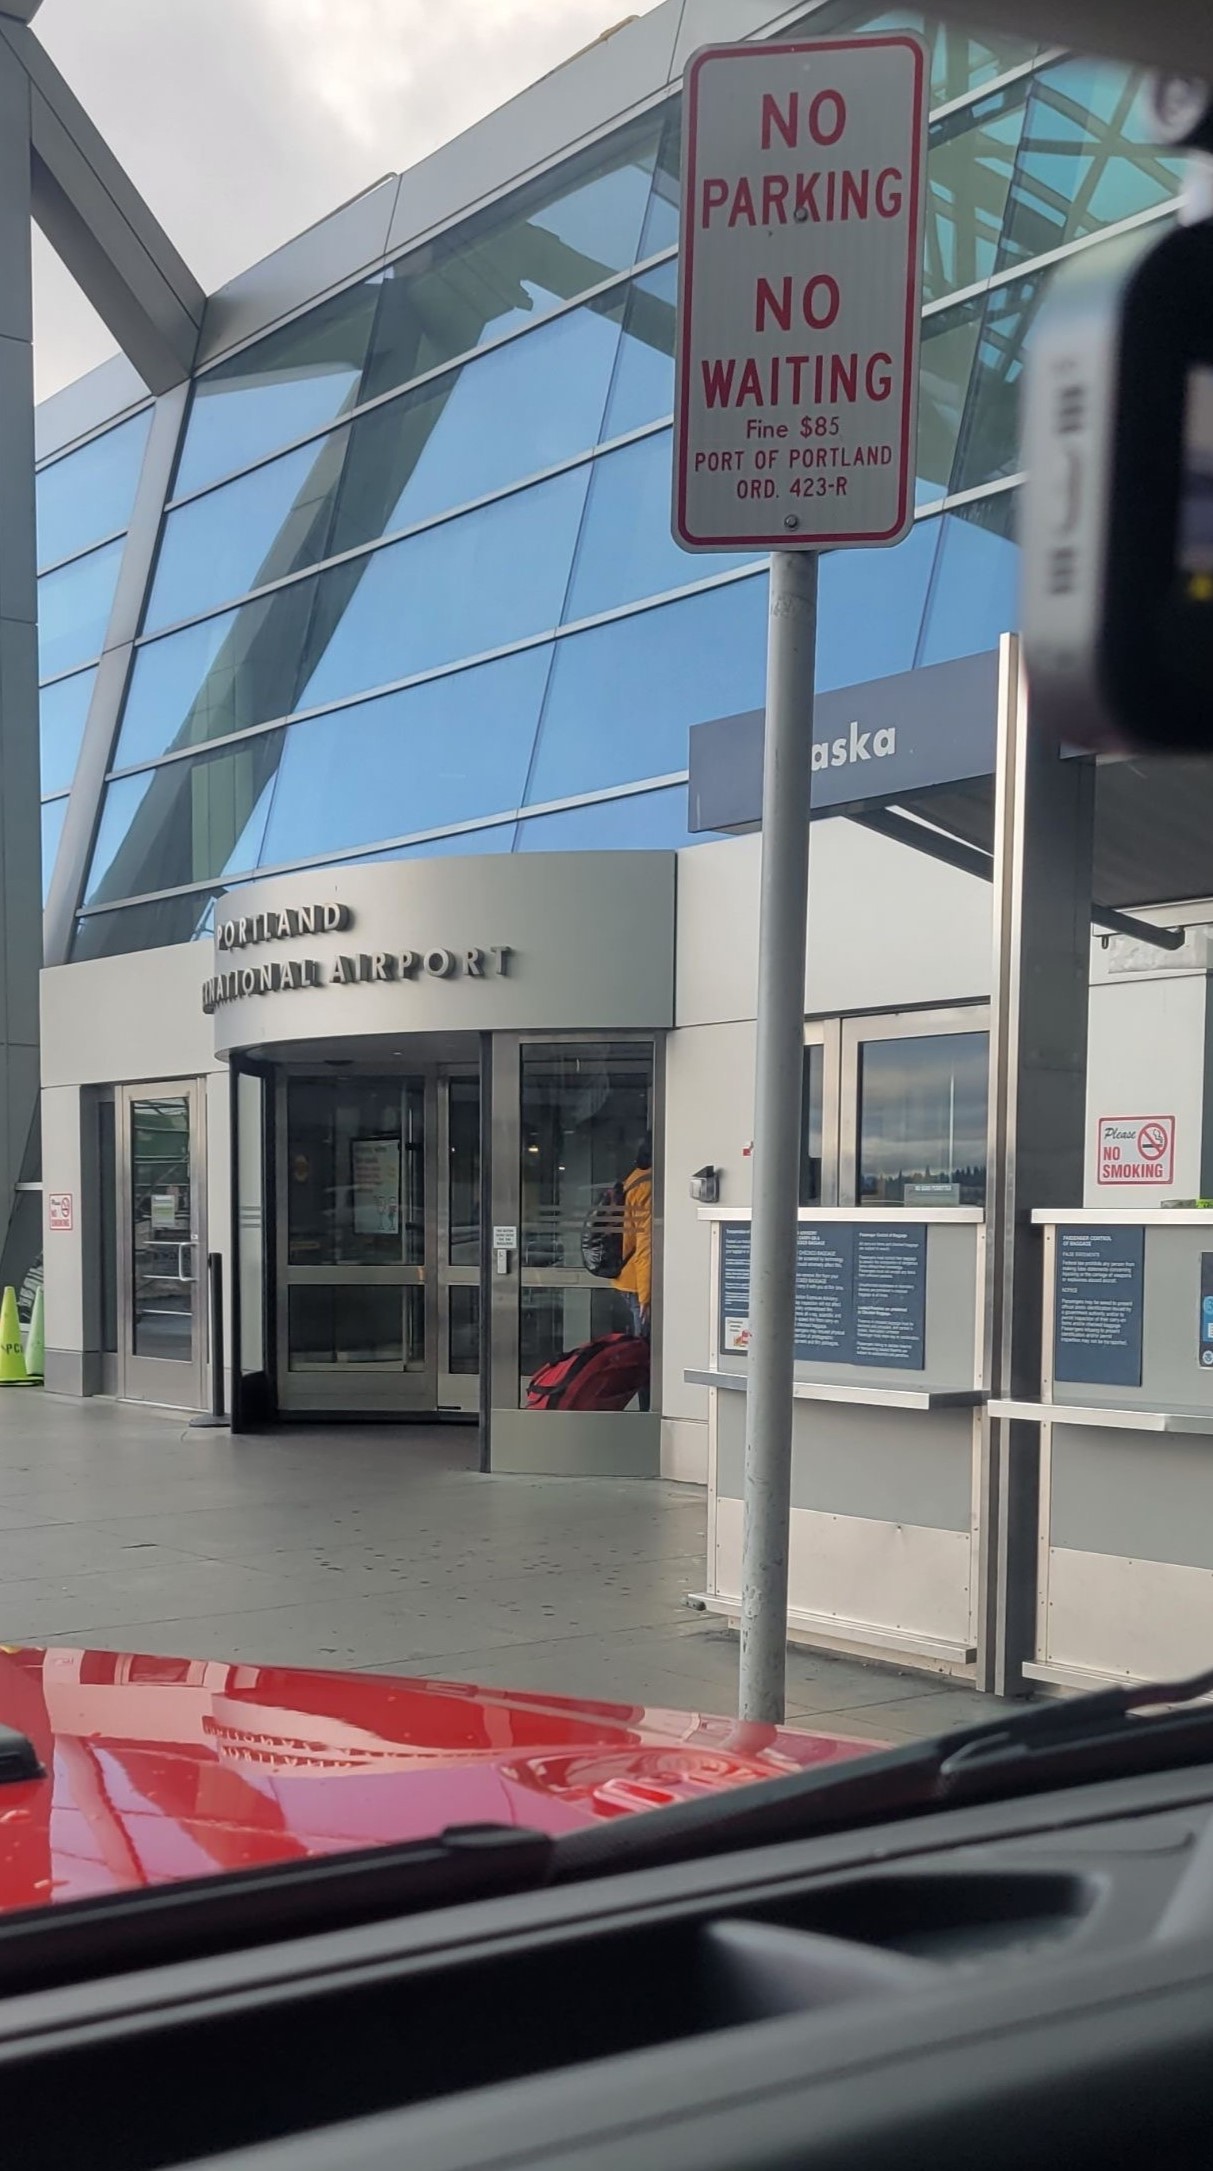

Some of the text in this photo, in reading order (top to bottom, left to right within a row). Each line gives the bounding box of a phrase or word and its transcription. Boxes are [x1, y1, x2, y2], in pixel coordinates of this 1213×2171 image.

[761, 89, 846, 149] NO
[702, 167, 903, 228] PARKING
[756, 274, 840, 332] NO
[702, 352, 892, 408] WAITING
[746, 415, 839, 439] Fine $85
[695, 446, 892, 472] PORT OF PORTLAND
[737, 476, 848, 499] ORD. 423-R
[811, 721, 896, 771] aska
[216, 902, 349, 949] PORTLAND
[202, 946, 512, 1006] NATIONAL AIRPORT
[1103, 1146, 1121, 1161] NO
[1104, 1127, 1136, 1140] Please
[1102, 1164, 1163, 1178] SMOKING
